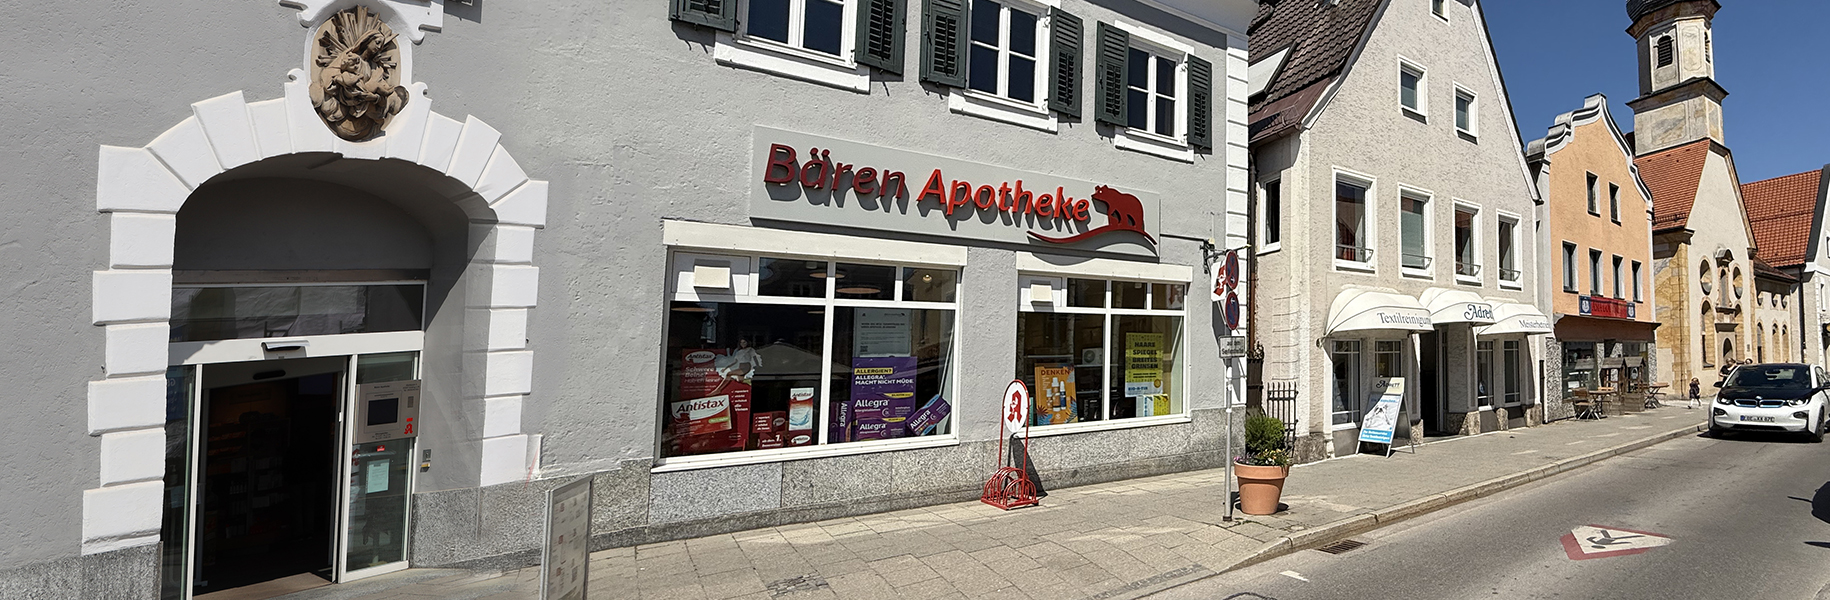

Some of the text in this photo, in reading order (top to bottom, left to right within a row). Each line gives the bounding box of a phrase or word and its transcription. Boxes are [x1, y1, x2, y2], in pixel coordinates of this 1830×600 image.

[763, 142, 1090, 221] Bären Apotheke
[676, 399, 726, 414] Antistax
[855, 399, 889, 408] Allegra
[839, 402, 848, 427] Allegra
[909, 409, 931, 429] Allegra
[859, 423, 887, 431] Allegra
